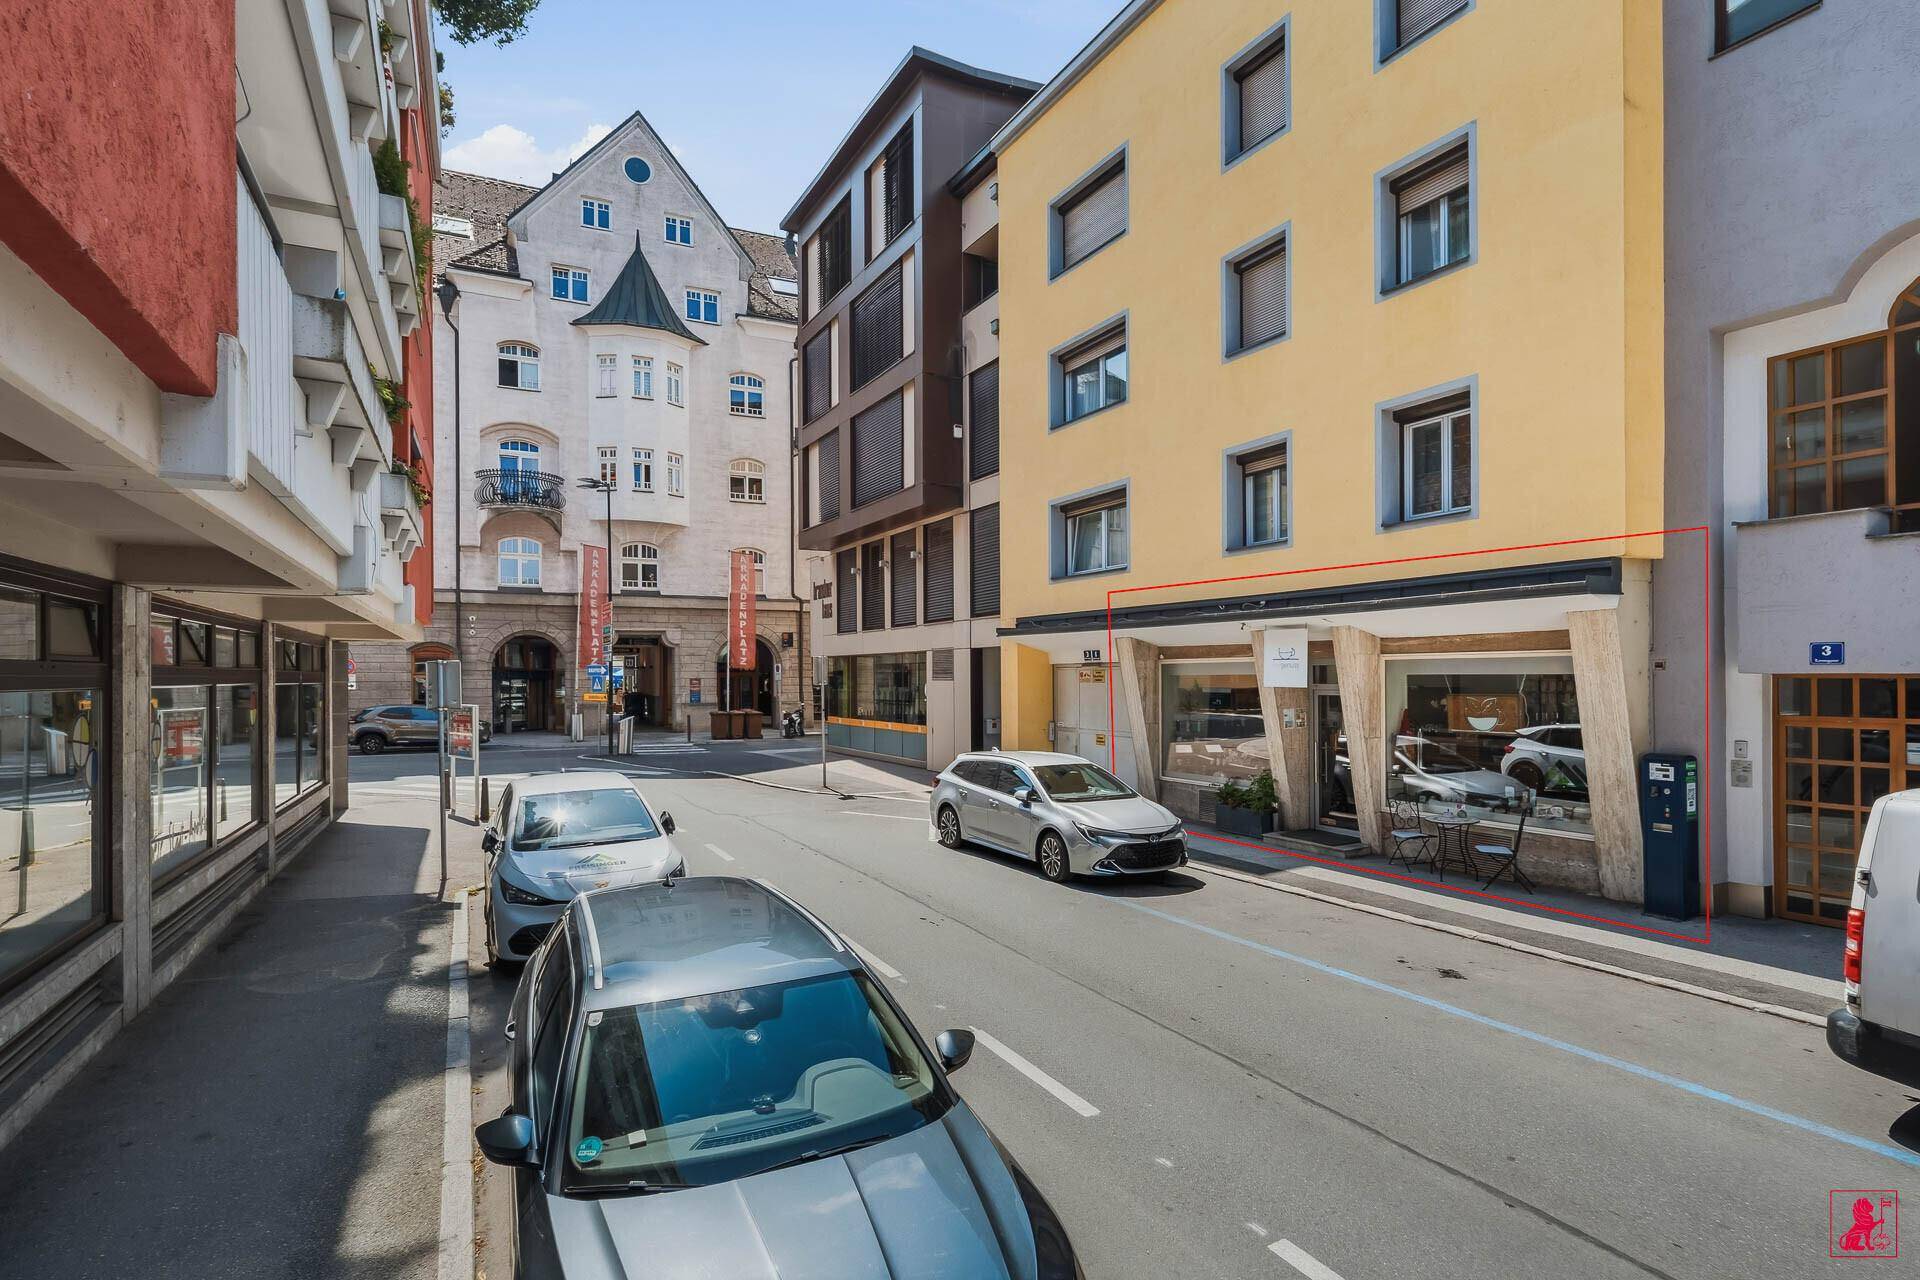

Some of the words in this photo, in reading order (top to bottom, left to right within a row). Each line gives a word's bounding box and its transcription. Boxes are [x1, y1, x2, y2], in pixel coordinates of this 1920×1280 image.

[590, 549, 600, 665] ARKADENPLATZ
[739, 555, 748, 665] ARKADENPLATZ
[1821, 645, 1832, 656] 3
[568, 860, 627, 871] FREISINGER
